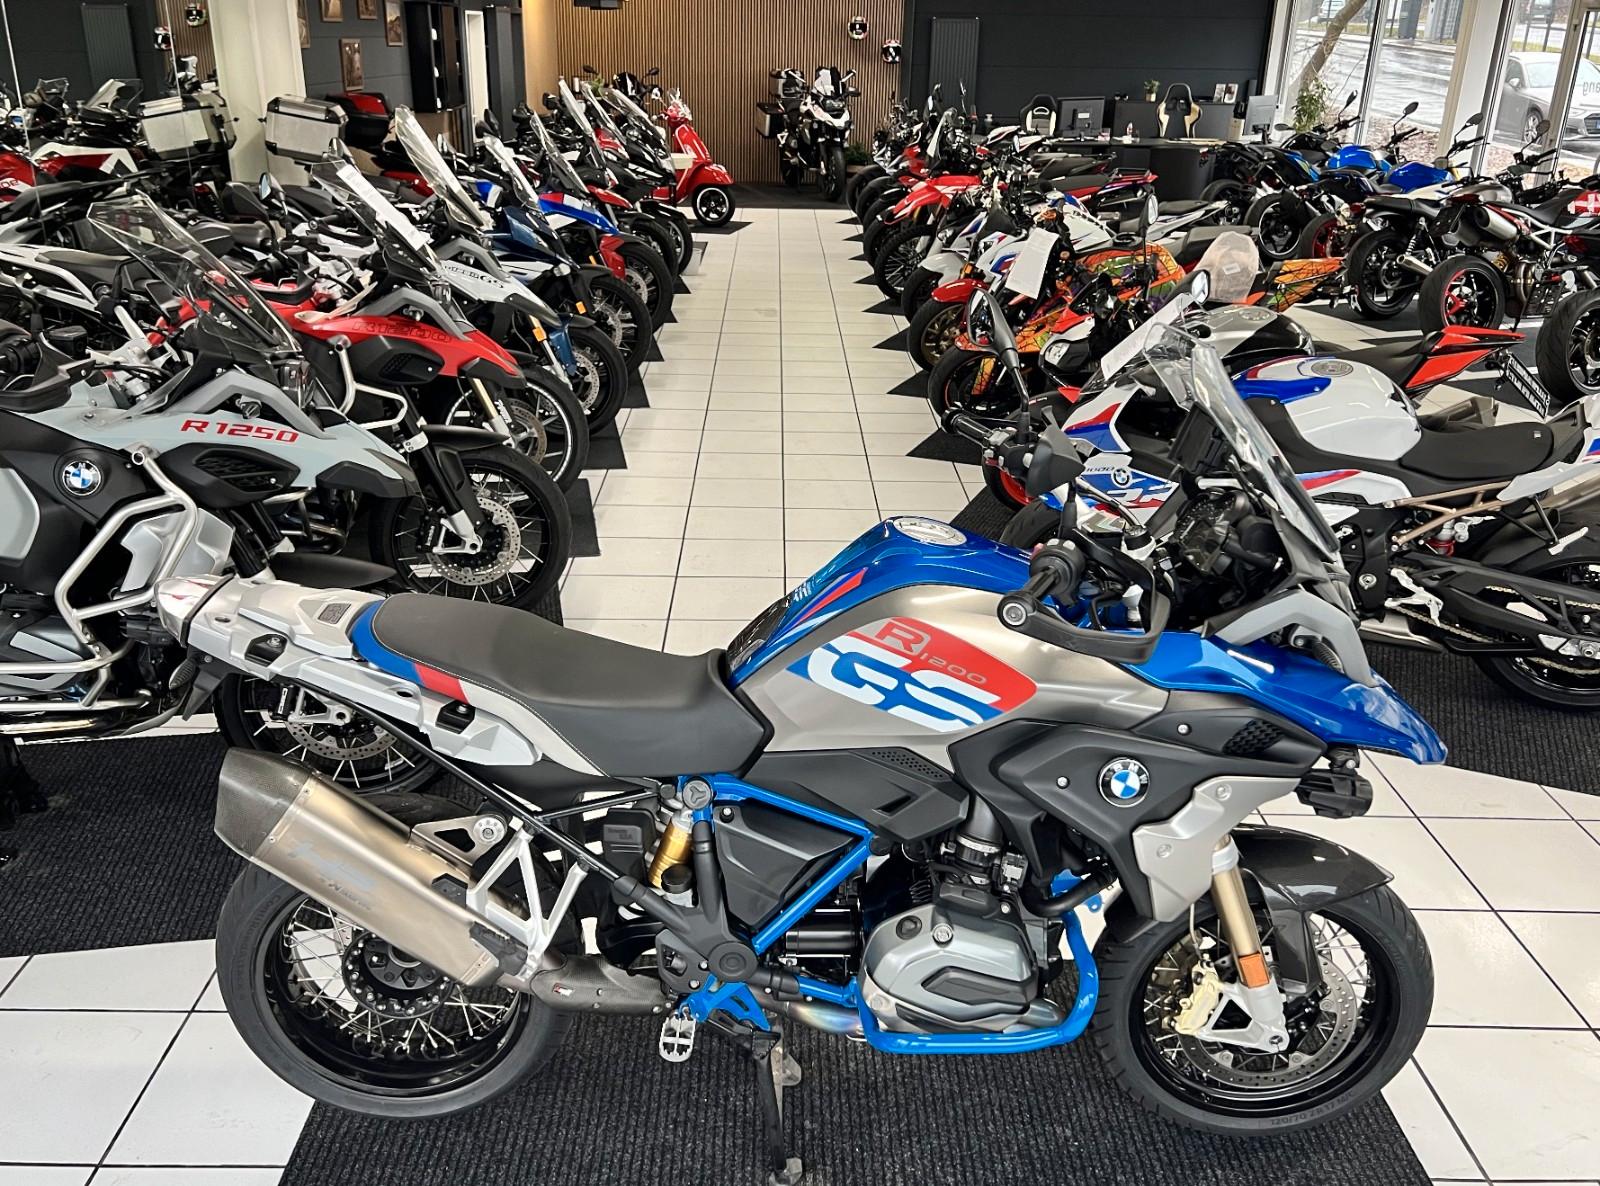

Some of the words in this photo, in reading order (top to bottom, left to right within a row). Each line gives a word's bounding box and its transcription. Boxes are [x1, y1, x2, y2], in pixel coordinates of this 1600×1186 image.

[181, 419, 209, 433] R
[216, 422, 299, 443] 1250
[807, 634, 1002, 733] GS
[874, 621, 925, 653] R
[921, 651, 988, 685] 1200
